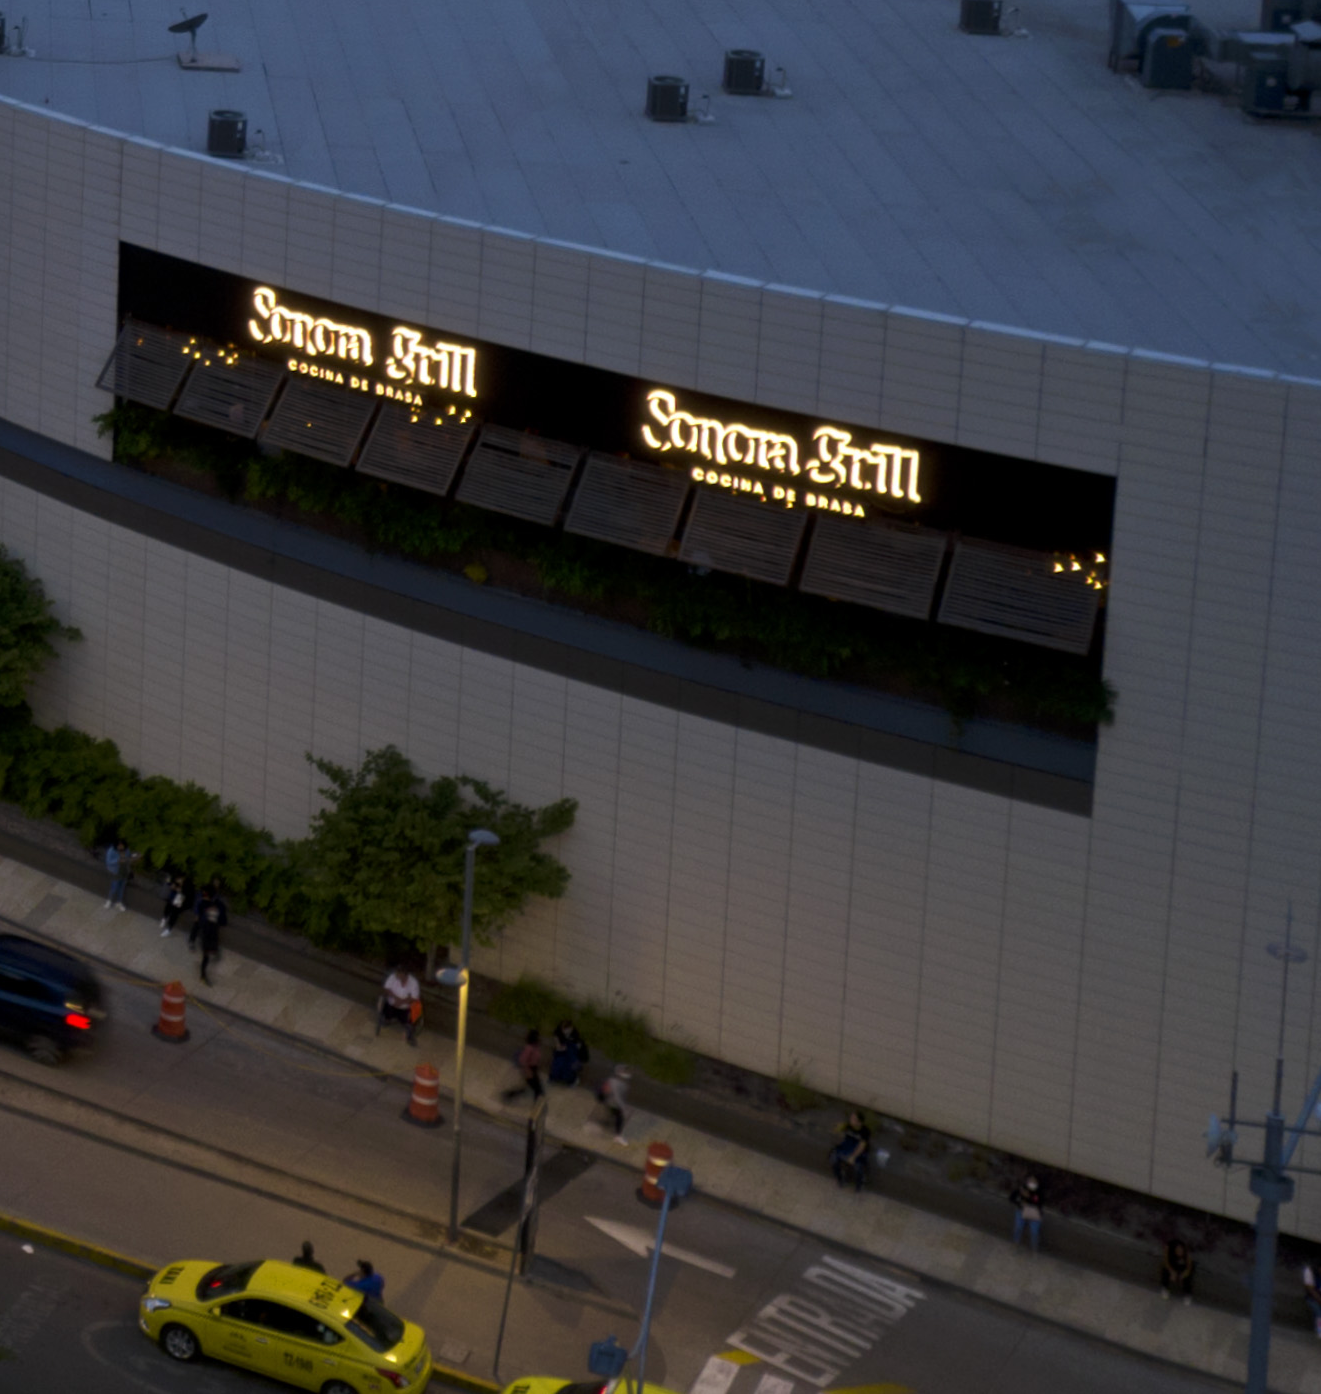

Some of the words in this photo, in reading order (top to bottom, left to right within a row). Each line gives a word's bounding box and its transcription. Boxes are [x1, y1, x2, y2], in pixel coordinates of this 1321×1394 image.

[249, 287, 374, 367] Sonora
[386, 325, 478, 398] Grill
[288, 359, 344, 385] COCINA
[350, 376, 369, 392] DE
[375, 383, 423, 406] BRASA
[642, 390, 801, 476] Sonora
[806, 425, 922, 503] Grill
[692, 467, 764, 495] COCINA
[773, 486, 797, 502] DE
[806, 492, 866, 518] BRASA
[725, 1254, 928, 1389] ENTRADA
